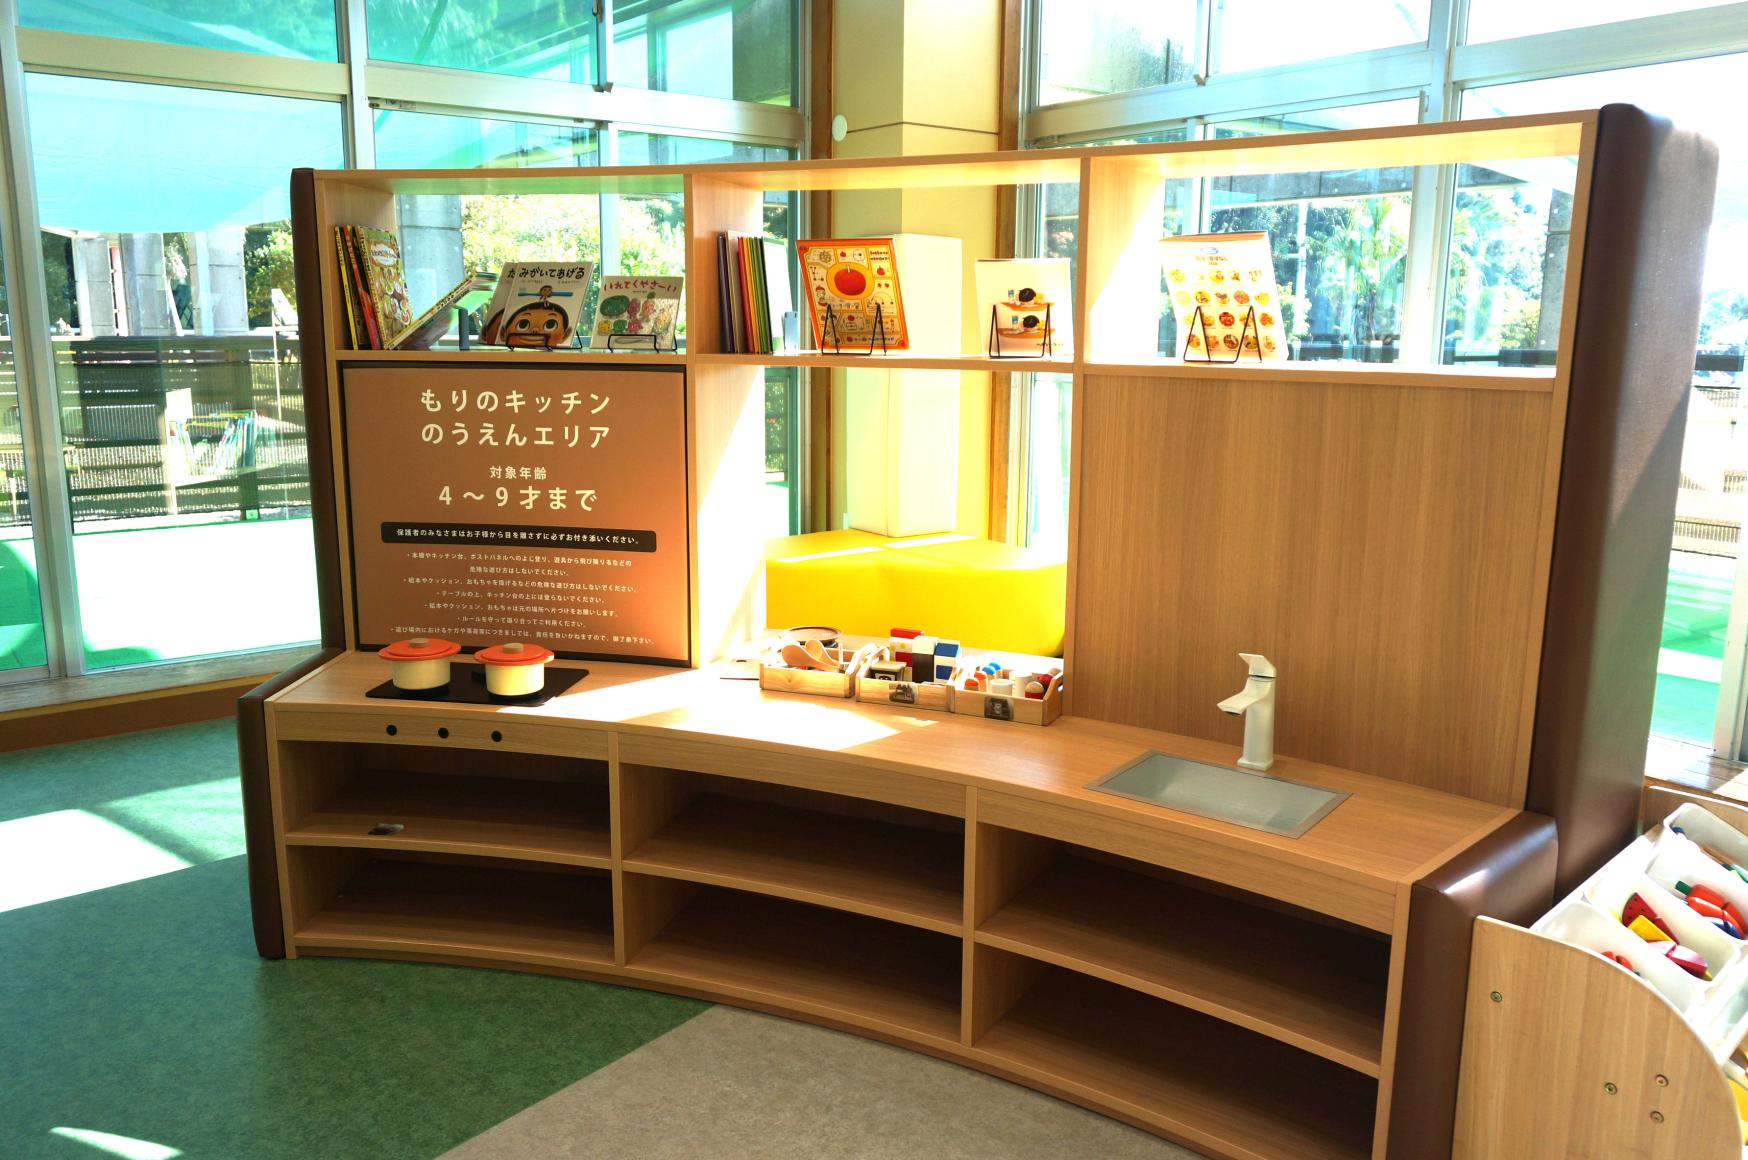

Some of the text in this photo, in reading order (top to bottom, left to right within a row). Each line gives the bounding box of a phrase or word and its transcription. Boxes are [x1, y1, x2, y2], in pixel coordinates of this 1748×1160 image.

[519, 266, 585, 279] みがいてあげる
[604, 279, 677, 292] いれてくやさーい
[421, 389, 611, 416] もりのキッチン
[421, 421, 611, 449] のうえんエリア
[488, 465, 547, 481] 対象年齢
[396, 528, 639, 544] 保護者のみなさまはお子様から目を離さずに必ずお付き添いください。
